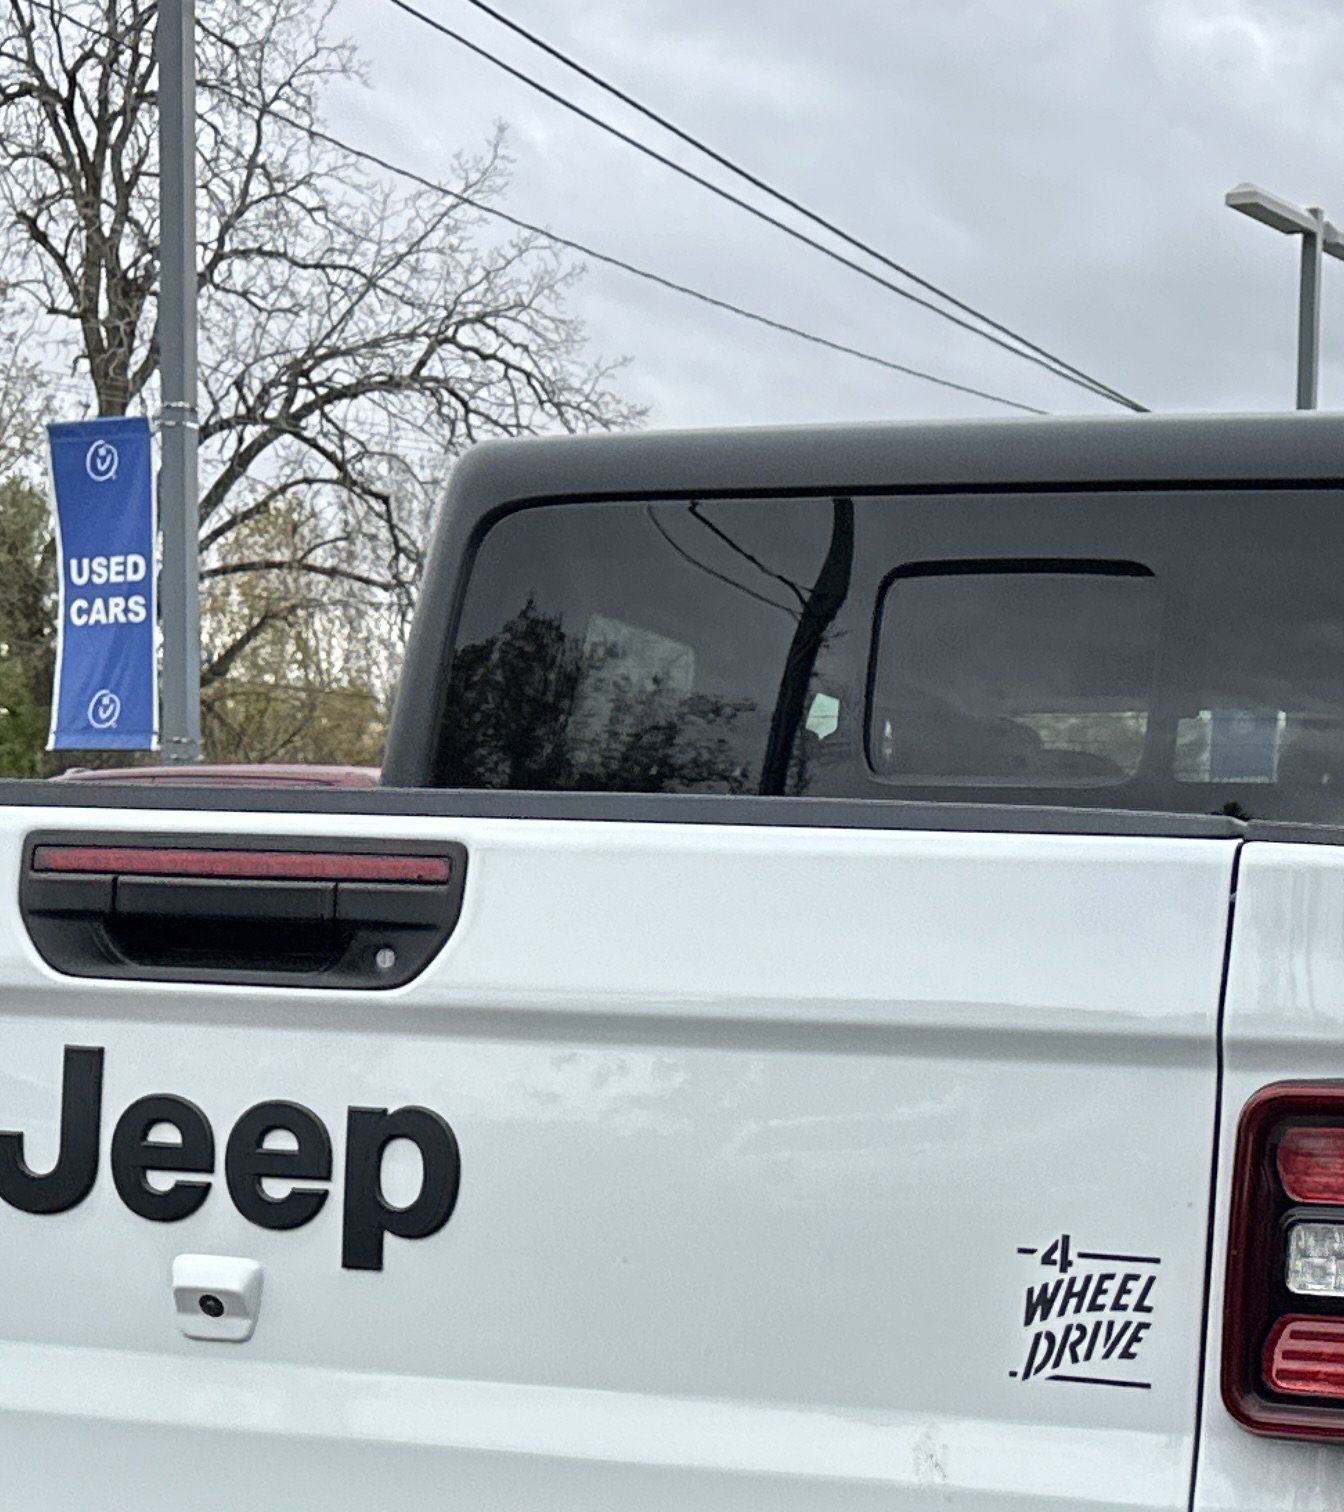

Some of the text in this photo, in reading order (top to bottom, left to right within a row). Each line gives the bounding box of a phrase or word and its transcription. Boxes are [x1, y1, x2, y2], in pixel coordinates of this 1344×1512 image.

[69, 553, 146, 586] USED
[69, 595, 147, 626] CARS
[1023, 1272, 1157, 1328] WHEEL
[1021, 1319, 1152, 1382] DRIVE
